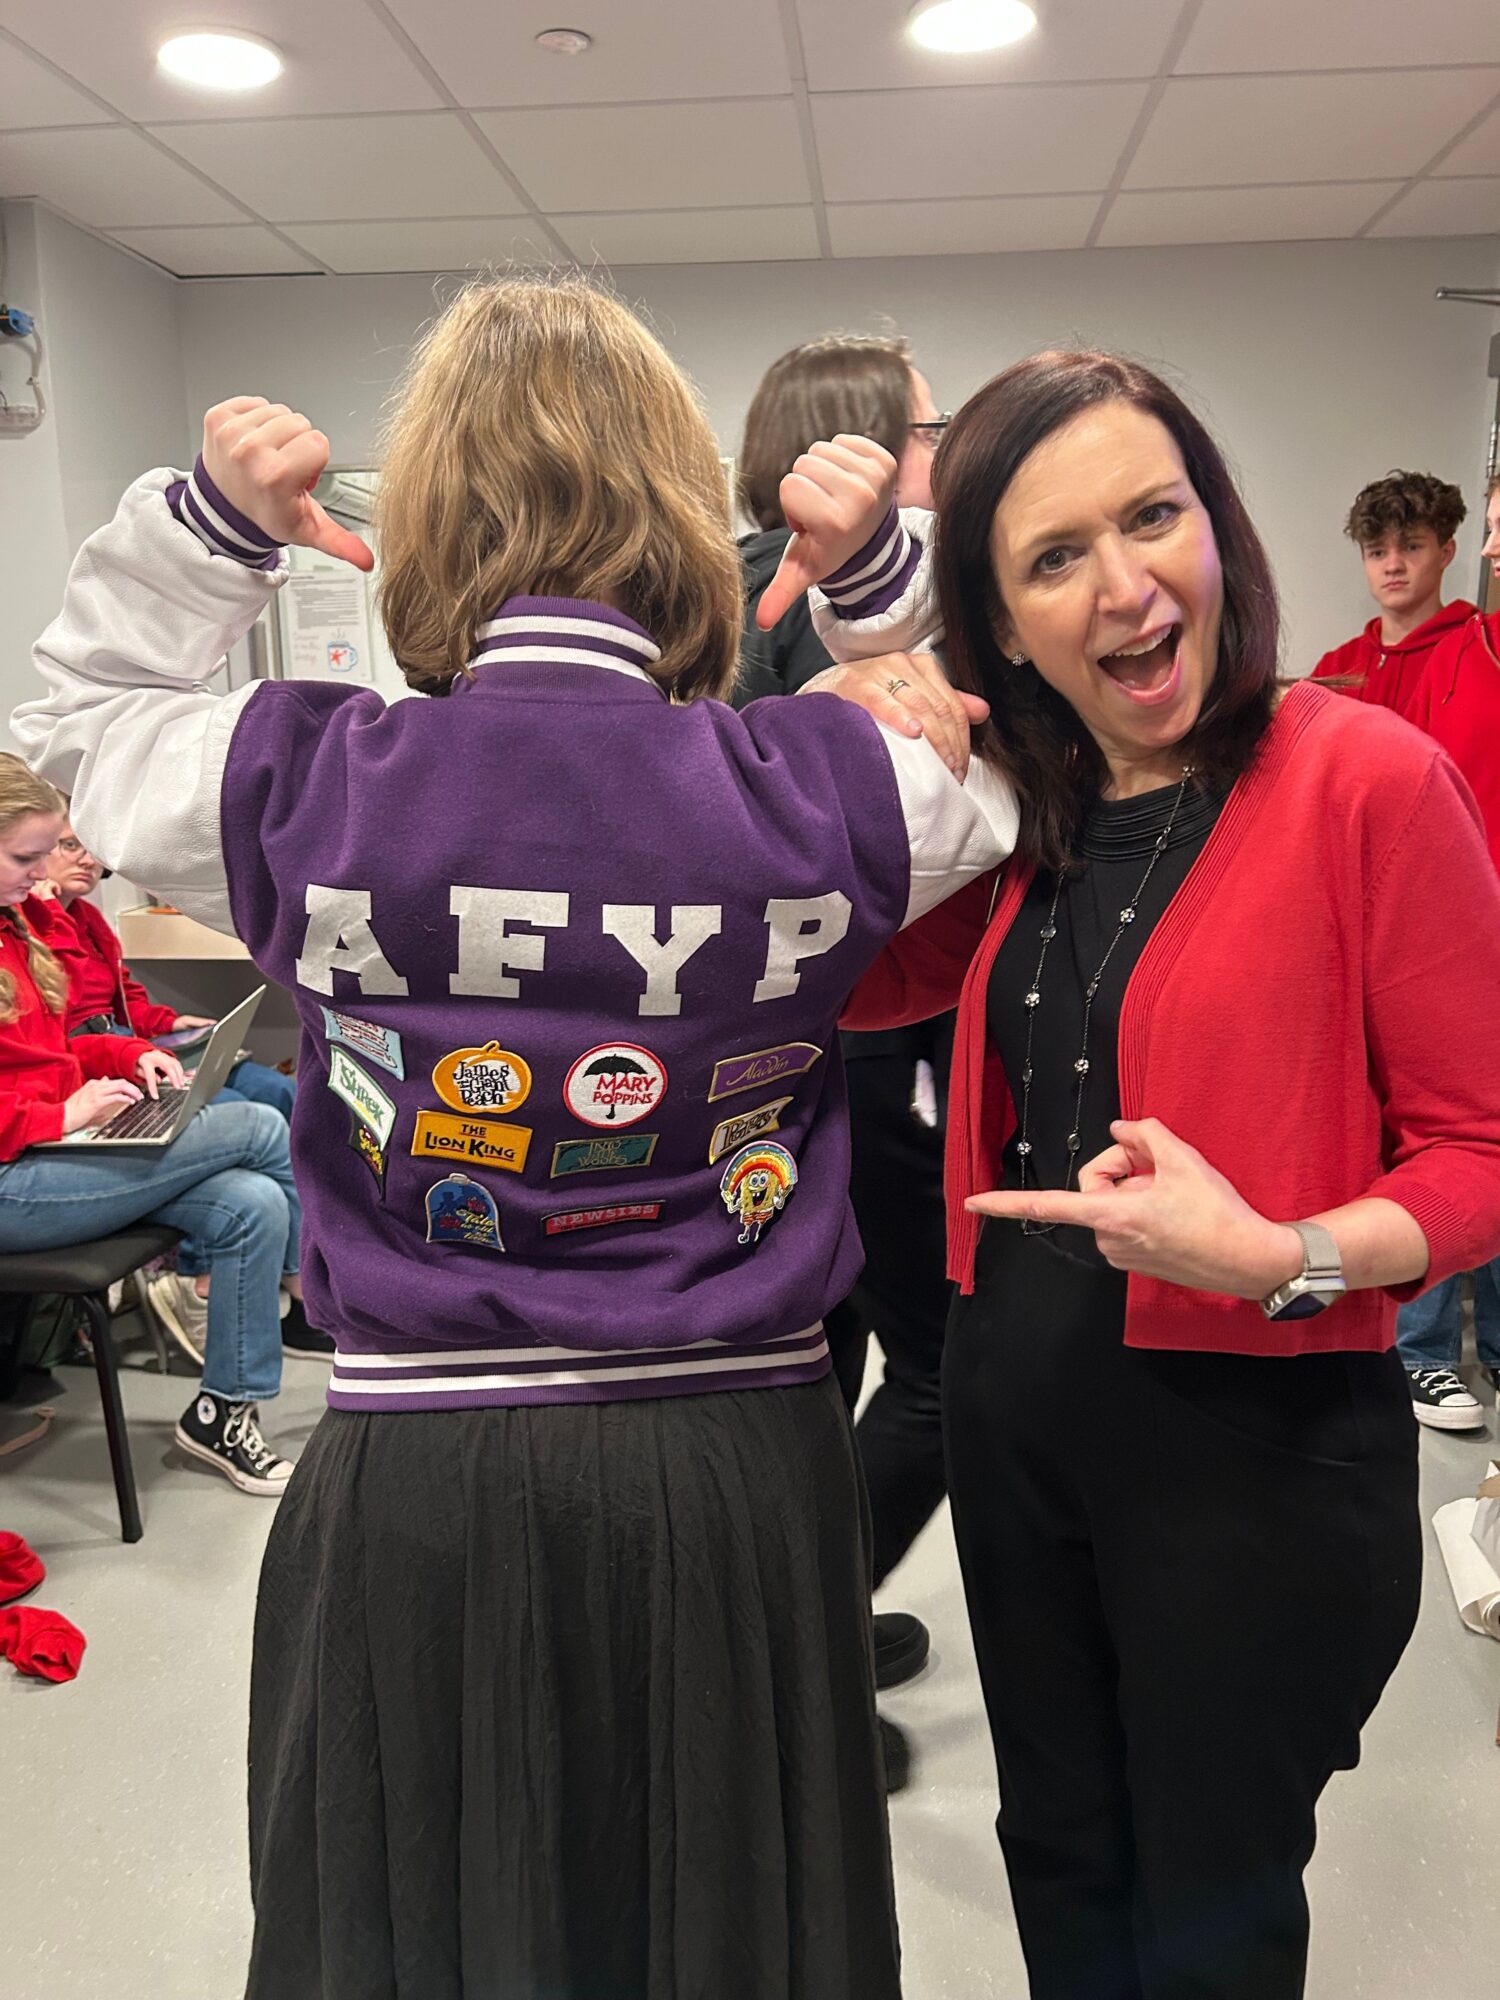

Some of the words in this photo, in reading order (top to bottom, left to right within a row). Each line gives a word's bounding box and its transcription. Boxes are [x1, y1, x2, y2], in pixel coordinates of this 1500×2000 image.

[296, 883, 853, 1016] AFYP
[453, 1061, 509, 1081] James
[726, 1056, 789, 1085] Aladdin
[469, 1075, 511, 1093] Giant
[597, 1074, 657, 1092] MARY
[460, 1089, 506, 1106] Peach
[593, 1091, 653, 1105] POPPINS
[461, 1124, 487, 1136] THE
[425, 1132, 465, 1149] LION
[469, 1139, 516, 1159] KING
[552, 1204, 654, 1225] NEWSIES
